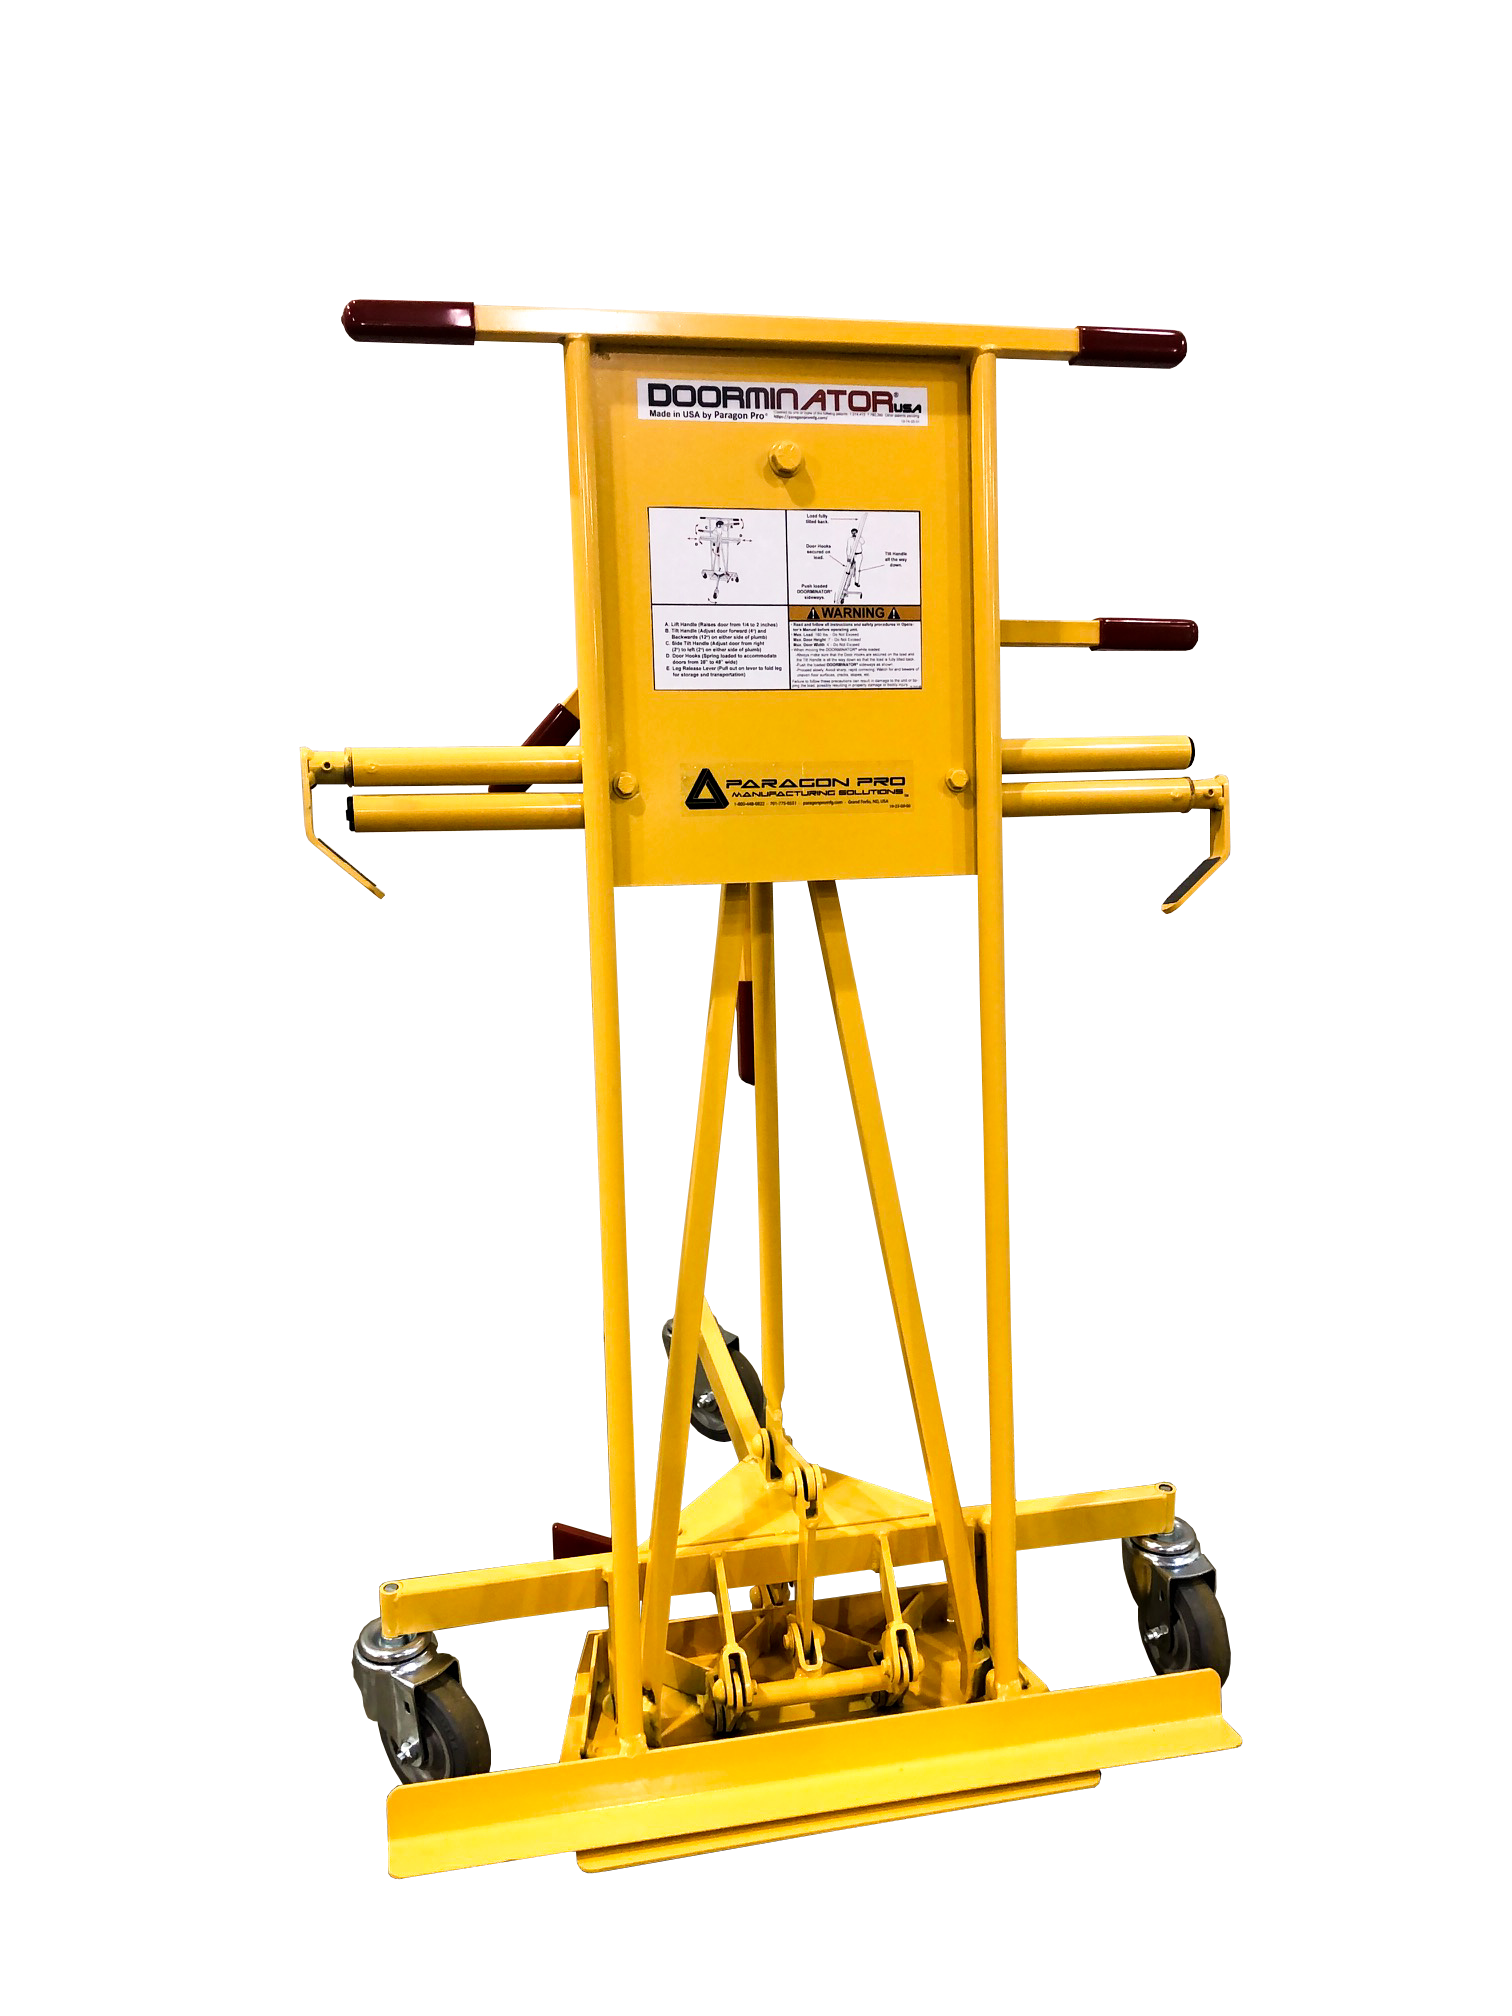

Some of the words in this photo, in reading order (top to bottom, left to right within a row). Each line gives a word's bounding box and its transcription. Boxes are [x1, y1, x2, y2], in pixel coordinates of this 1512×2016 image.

[894, 403, 922, 414] USA
[649, 409, 671, 417] Made
[702, 411, 712, 420] by
[714, 410, 748, 421] Paragon
[821, 607, 885, 619] WARNING
[726, 778, 850, 788] PARAGON
[857, 776, 906, 786] PRO
